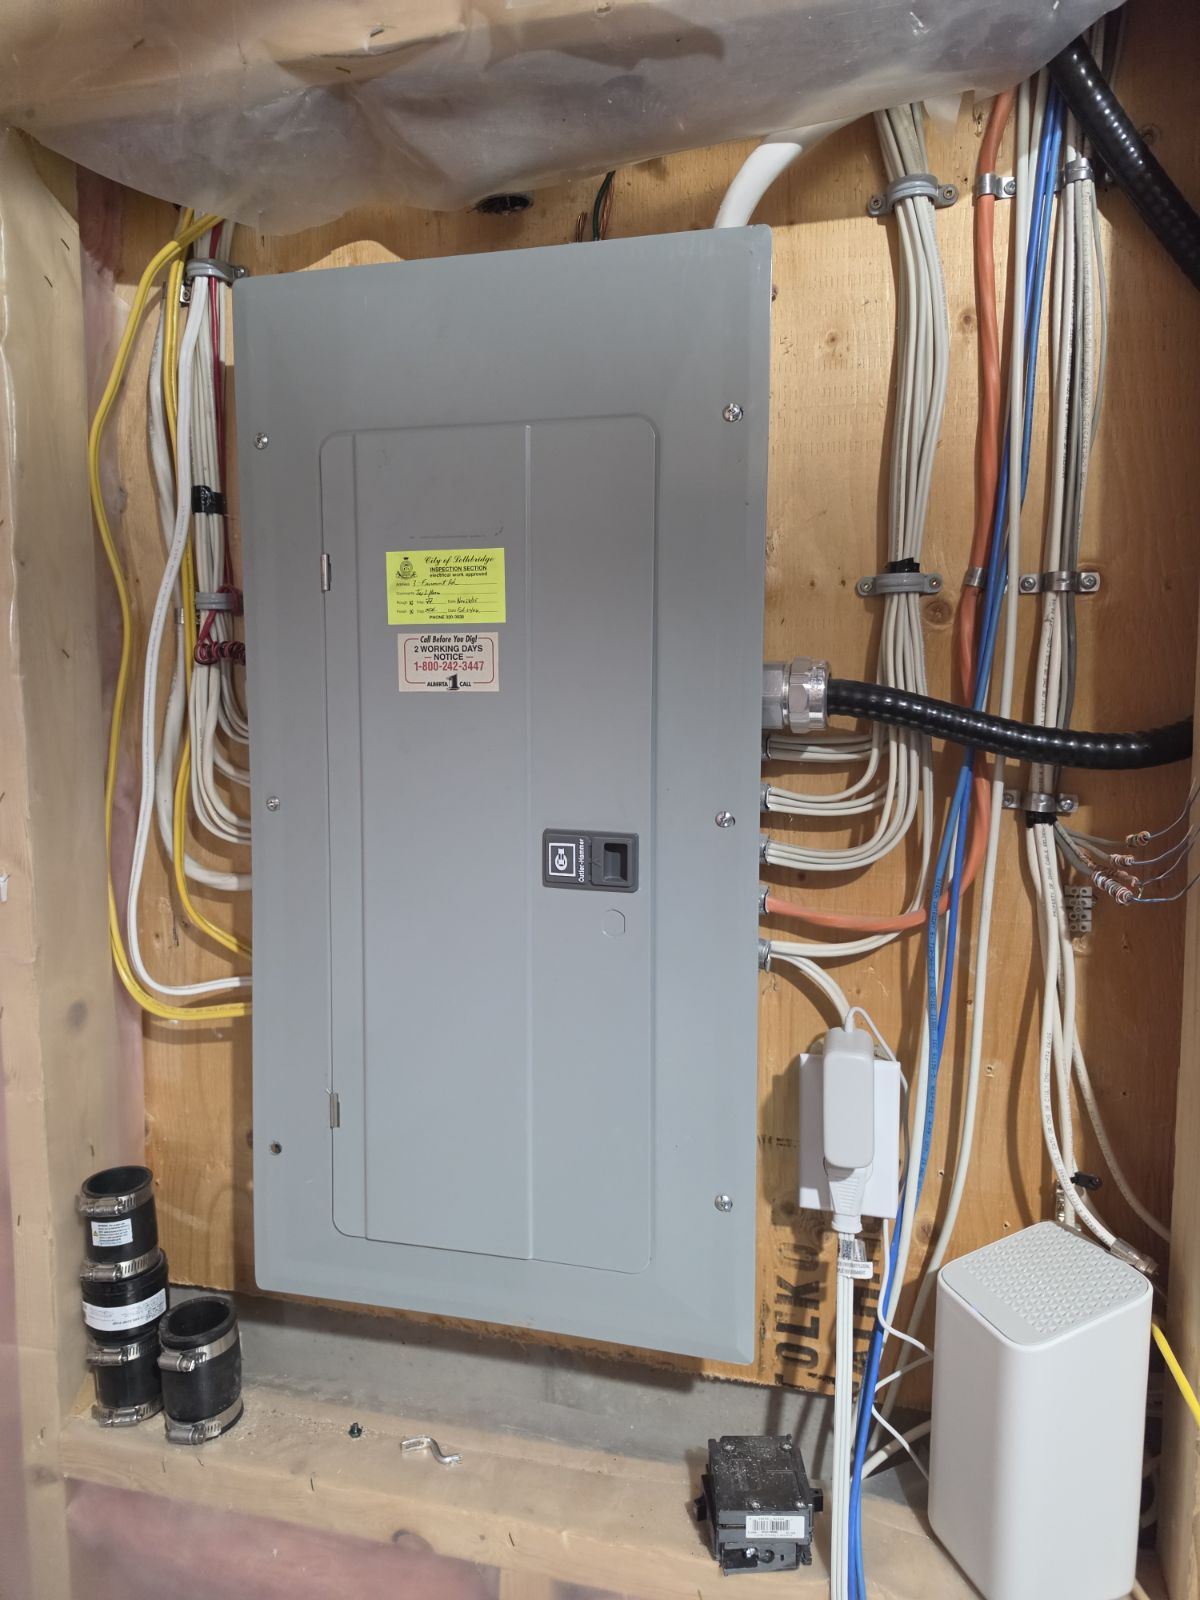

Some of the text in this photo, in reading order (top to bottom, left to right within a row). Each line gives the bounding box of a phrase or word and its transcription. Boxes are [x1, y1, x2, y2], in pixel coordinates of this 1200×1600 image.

[420, 634, 478, 644] Call Before You Dig!
[420, 645, 459, 653] WORKING
[433, 653, 464, 661] NOTICE
[414, 661, 484, 671] 1-800-242-3447
[446, 673, 460, 691] 1
